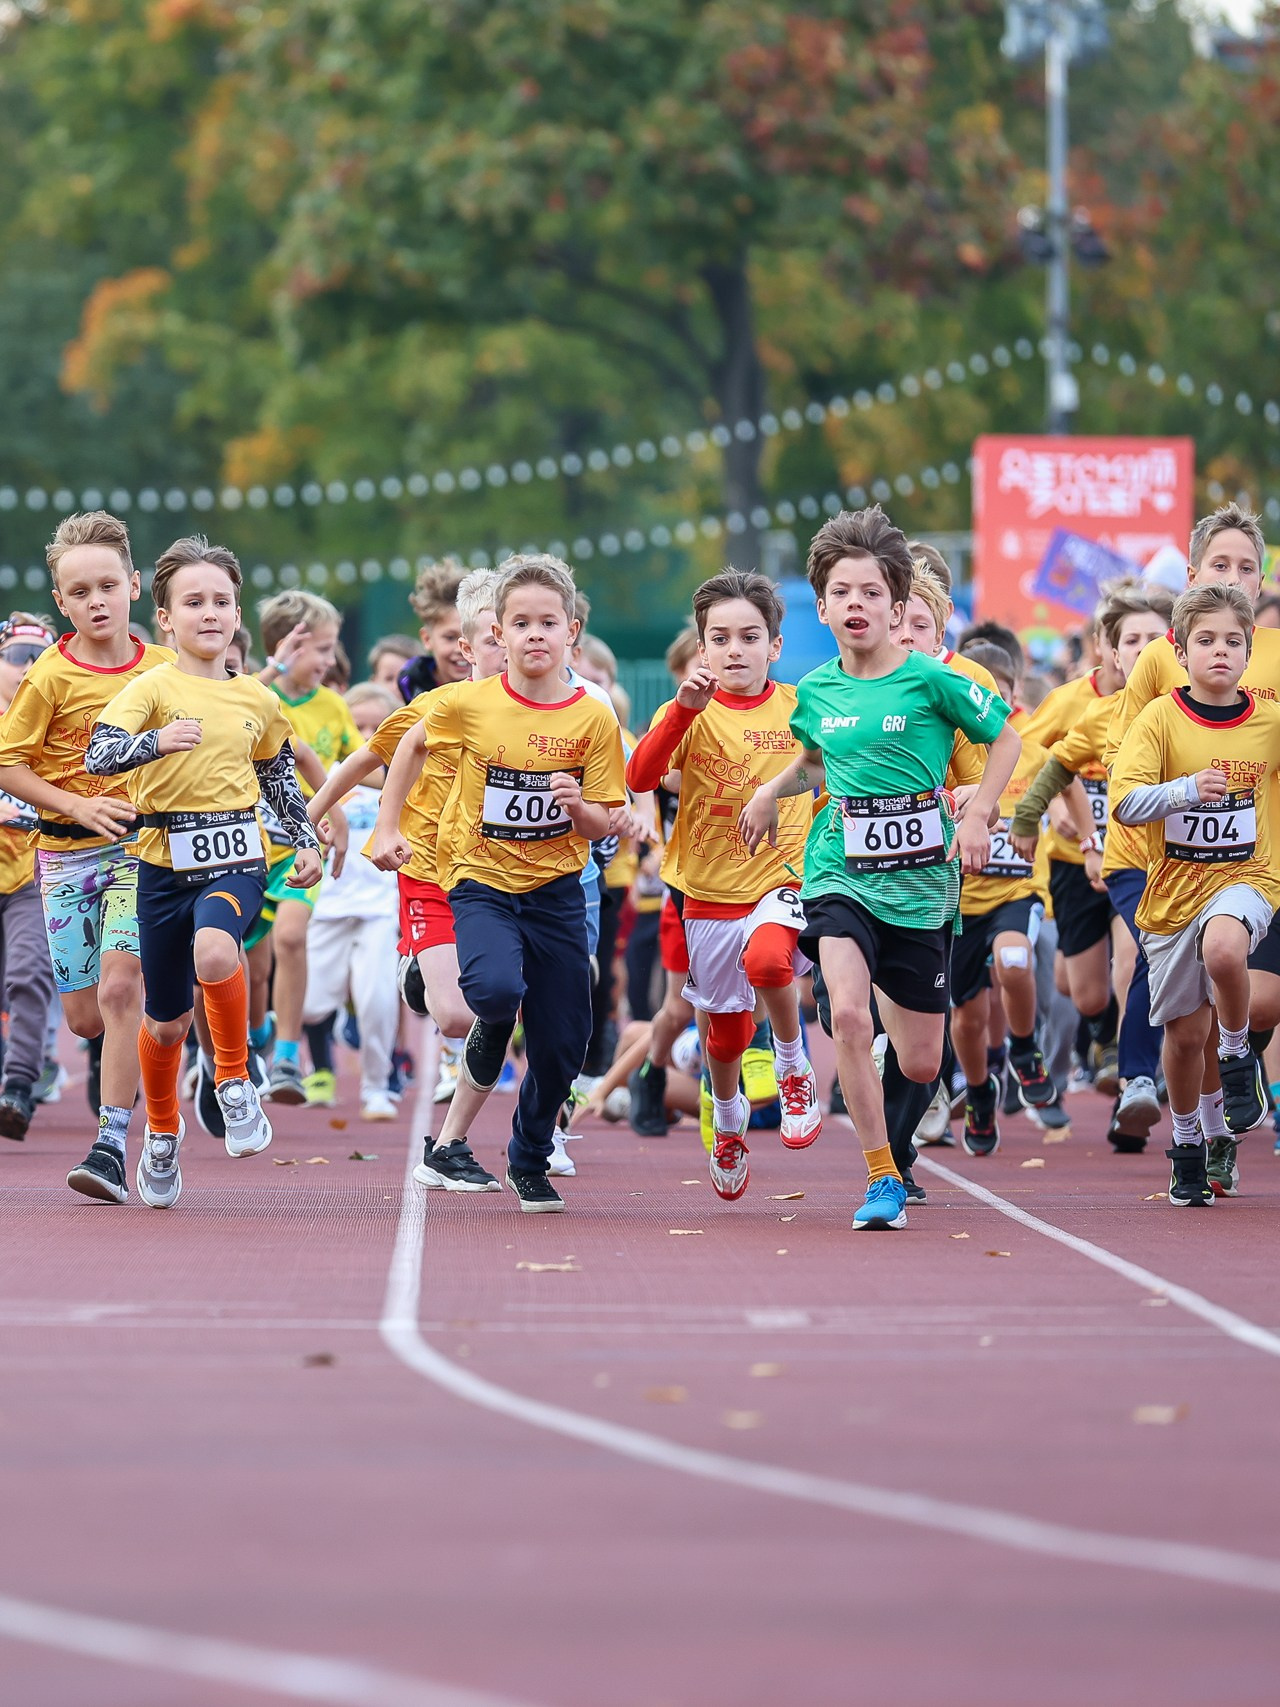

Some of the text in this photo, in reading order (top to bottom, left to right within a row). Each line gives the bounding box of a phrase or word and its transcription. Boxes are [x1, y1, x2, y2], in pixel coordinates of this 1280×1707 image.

[821, 716, 861, 728] RUNIT
[744, 730, 796, 743] ДЕТСКИ
[491, 769, 515, 779] 2026
[505, 794, 562, 823] 606
[864, 818, 924, 851] 608
[1183, 815, 1239, 842] 704
[192, 828, 248, 863] 808
